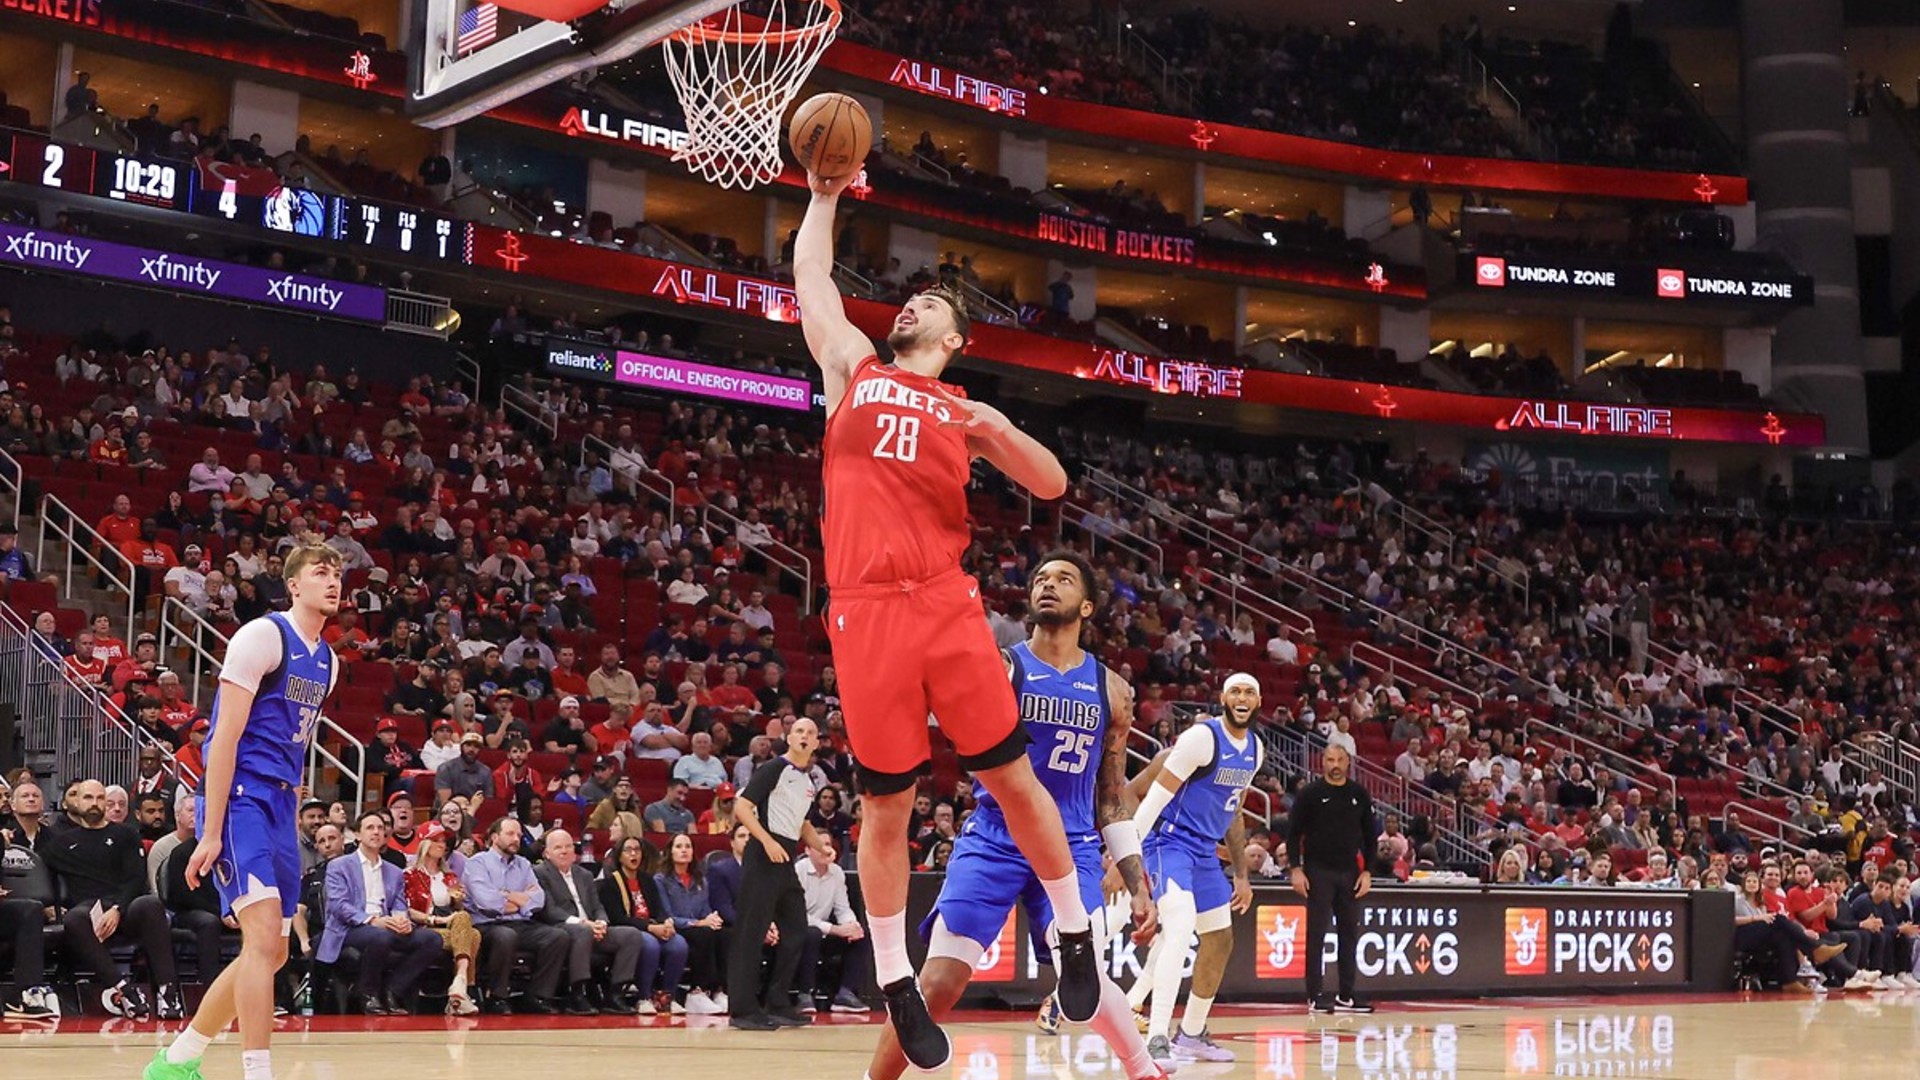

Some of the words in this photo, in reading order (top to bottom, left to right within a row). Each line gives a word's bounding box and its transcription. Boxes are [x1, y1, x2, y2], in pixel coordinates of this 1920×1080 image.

[889, 58, 951, 96] ALL
[955, 74, 1026, 116] FIRE
[559, 107, 618, 138] ALL
[43, 144, 64, 188] 2
[114, 157, 176, 199] 10:29
[218, 179, 238, 219] 4
[5, 231, 92, 268] xfinity
[365, 222, 376, 244] 7
[401, 229, 412, 251] 0
[438, 235, 447, 258] 1
[1038, 212, 1107, 252] HOUSTON
[1115, 229, 1195, 264] ROCKETS
[140, 254, 221, 290] xfinity
[652, 265, 731, 307] ALL
[1508, 265, 1568, 284] TUNDRA
[1573, 269, 1616, 287] ZONE
[1688, 277, 1747, 296] TUNDRA
[1751, 281, 1793, 298] ZONE
[266, 275, 343, 310] xfinity
[549, 349, 597, 370] reliant
[1094, 350, 1154, 386] ALL
[1160, 361, 1242, 398] FIRE
[621, 359, 685, 384] OFFICIAL
[687, 372, 740, 392] ENERGY
[741, 379, 805, 402] PROVIDER
[873, 413, 921, 463] 28
[1510, 401, 1582, 430] ALL
[1586, 405, 1672, 435] FIRE
[1022, 692, 1100, 731] DALLAS
[1048, 729, 1095, 774] 25
[1554, 909, 1674, 928] DRAFTKINGS
[1321, 931, 1414, 977] PCK
[1432, 931, 1459, 977] 6
[1554, 932, 1637, 973] PICK
[1651, 932, 1674, 973] 6
